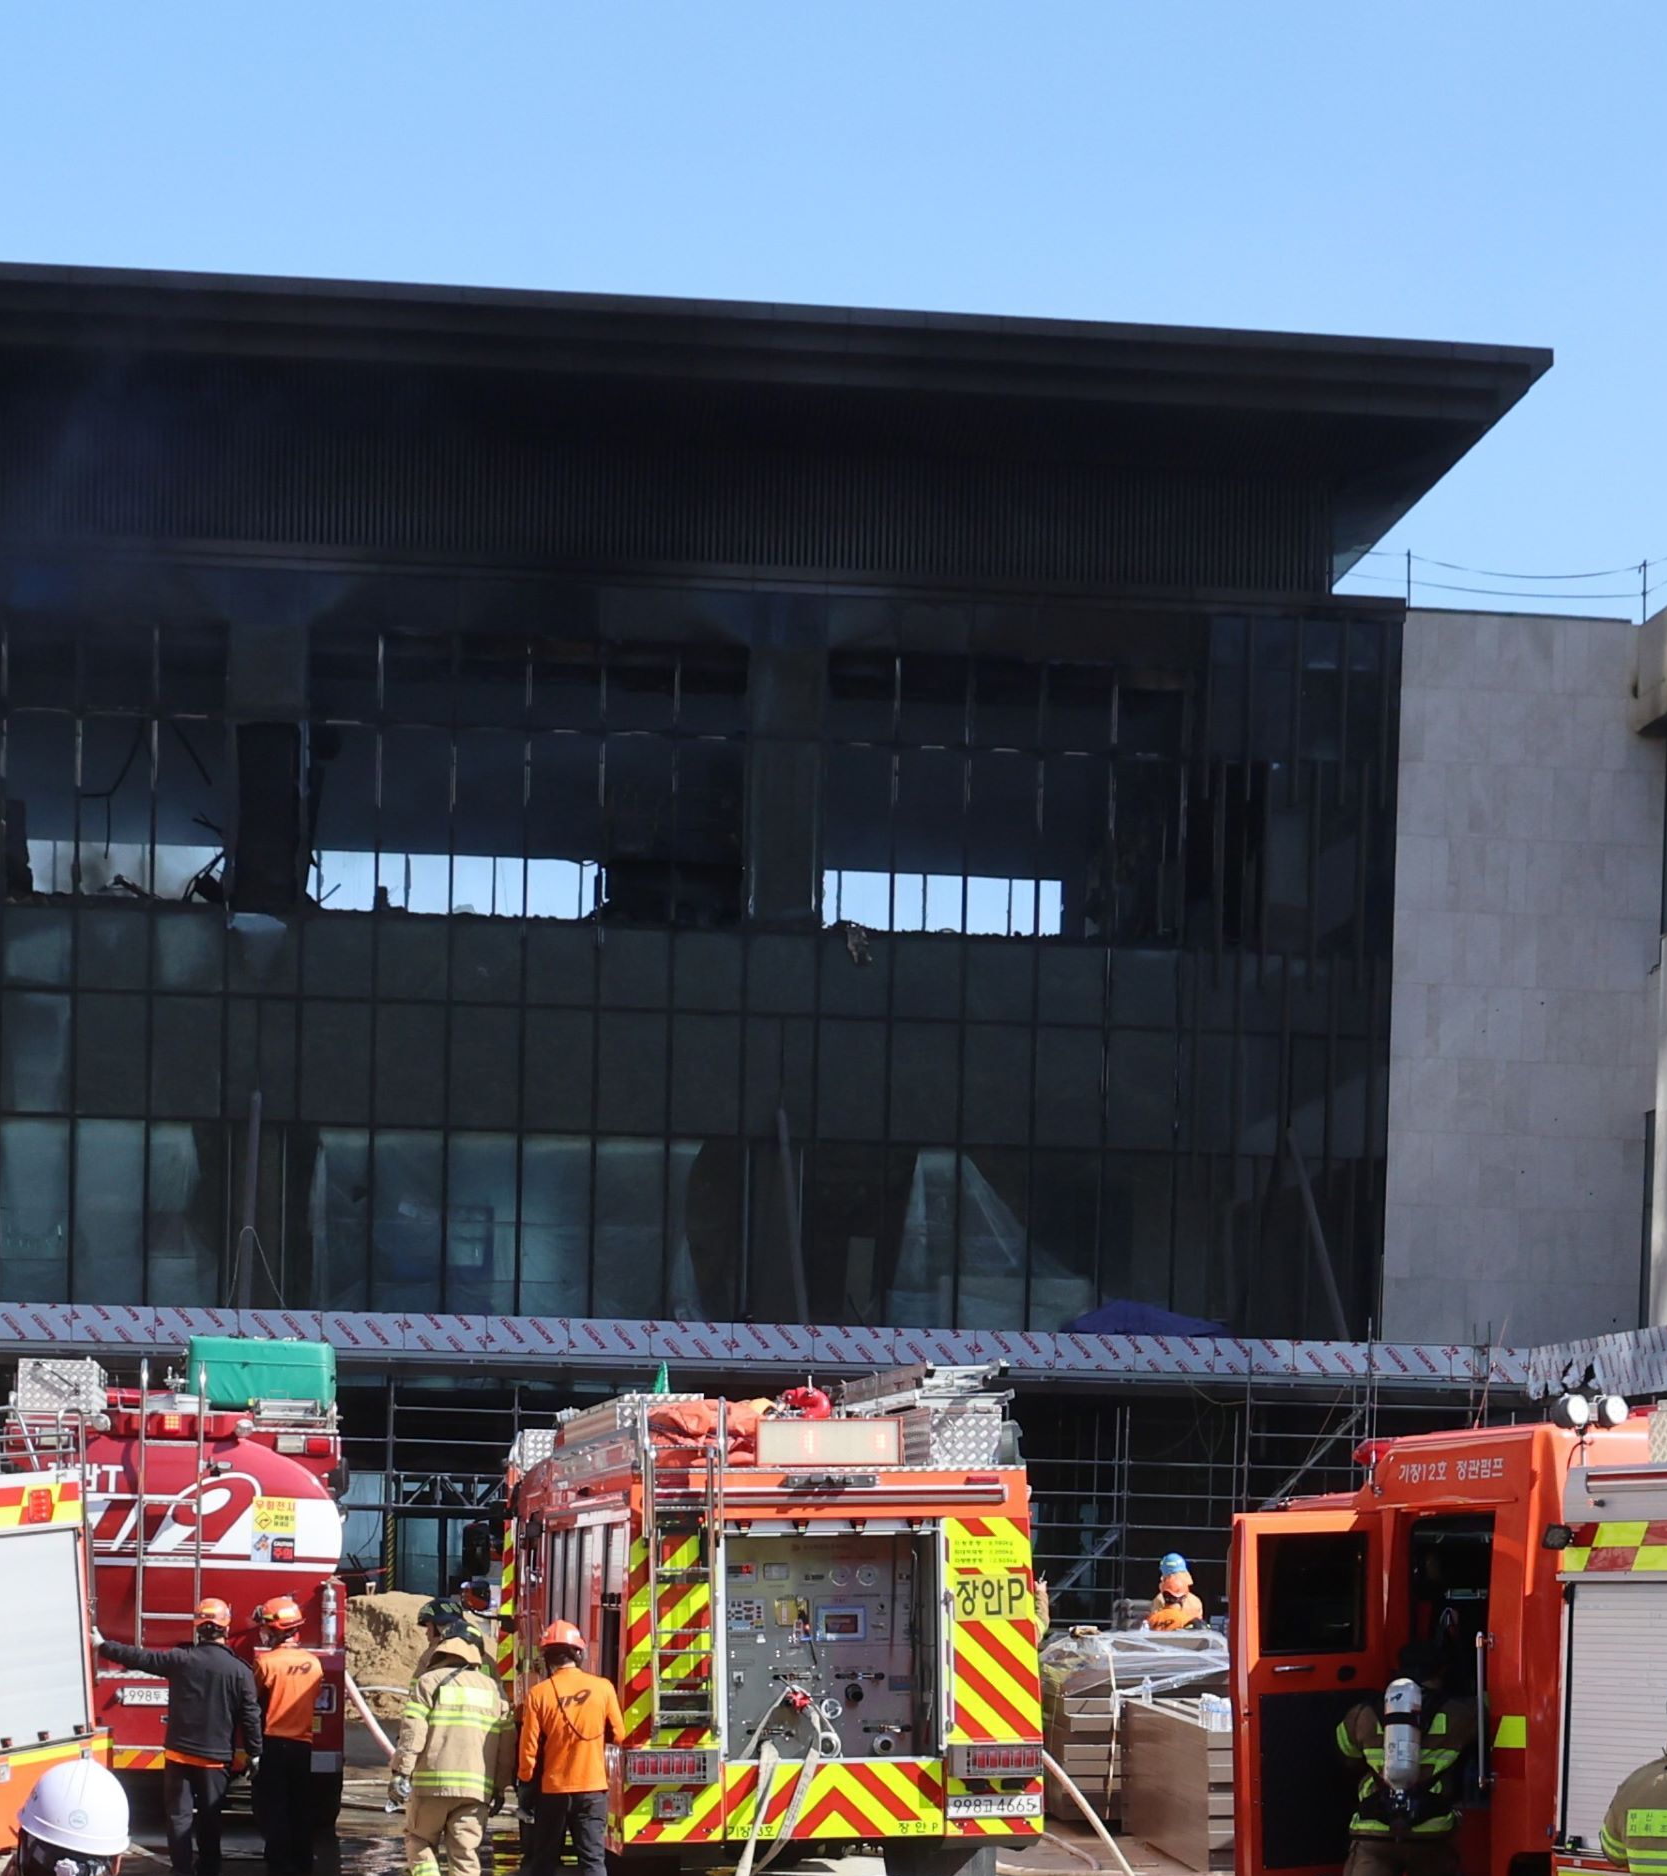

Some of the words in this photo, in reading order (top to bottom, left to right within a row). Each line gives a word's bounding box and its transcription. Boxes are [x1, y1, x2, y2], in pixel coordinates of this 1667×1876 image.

[1399, 1461, 1449, 1484] 기장12호
[1455, 1457, 1504, 1480] 정관펌프
[956, 1579, 1025, 1616] 장안P
[286, 1662, 312, 1676] 119
